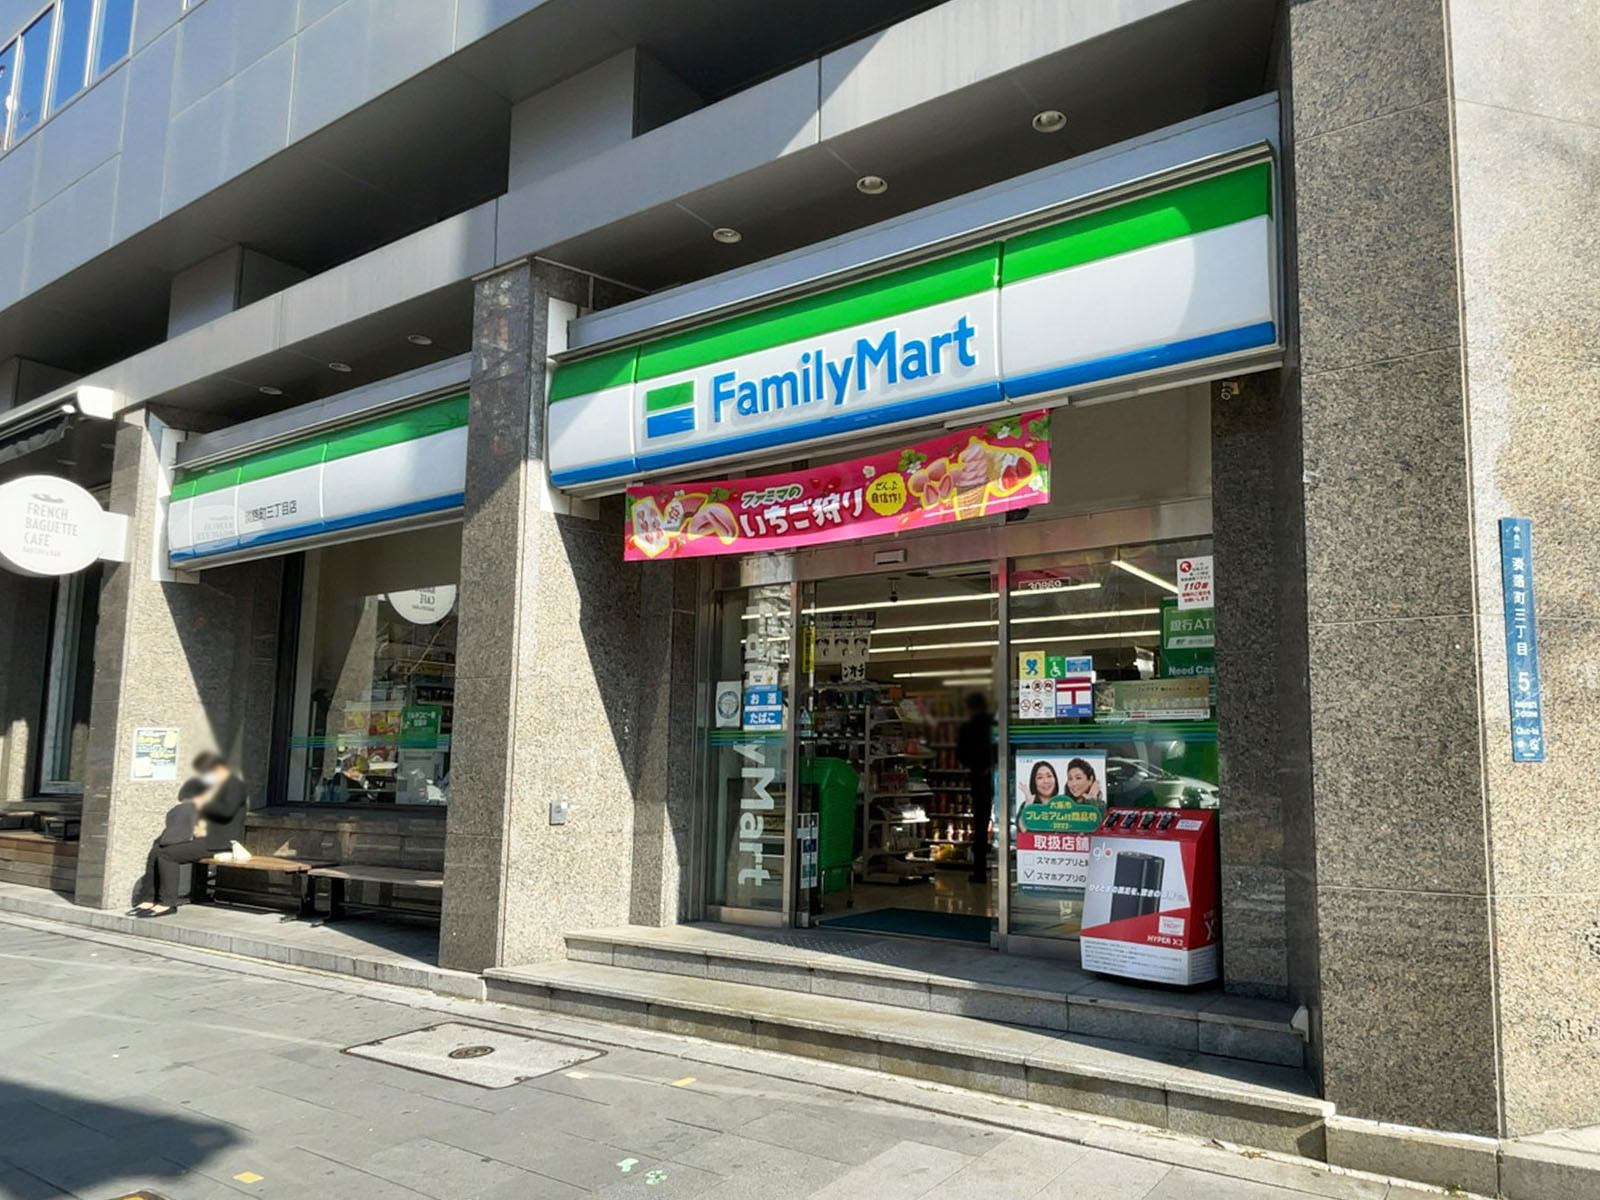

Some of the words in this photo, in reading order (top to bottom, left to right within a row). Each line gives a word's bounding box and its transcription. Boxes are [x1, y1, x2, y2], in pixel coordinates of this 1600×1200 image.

[713, 315, 976, 423] FamilyMart
[875, 480, 898, 490] ぜんぶ
[742, 485, 802, 507] ファミマの
[26, 502, 69, 521] FRENCH
[739, 488, 863, 537] いちご狩り
[25, 517, 79, 537] BAGUETTE
[24, 532, 51, 547] CAFE
[1170, 618, 1215, 632] 銀行AT
[1168, 665, 1195, 676] Need
[1518, 671, 1531, 692] 5
[750, 692, 777, 705] お酒
[750, 712, 776, 724] たばこ
[1033, 835, 1090, 852] 取扱店舗
[1092, 841, 1112, 860] glo
[1037, 871, 1087, 883] スマホアプリの
[1147, 935, 1172, 944] HYPER
